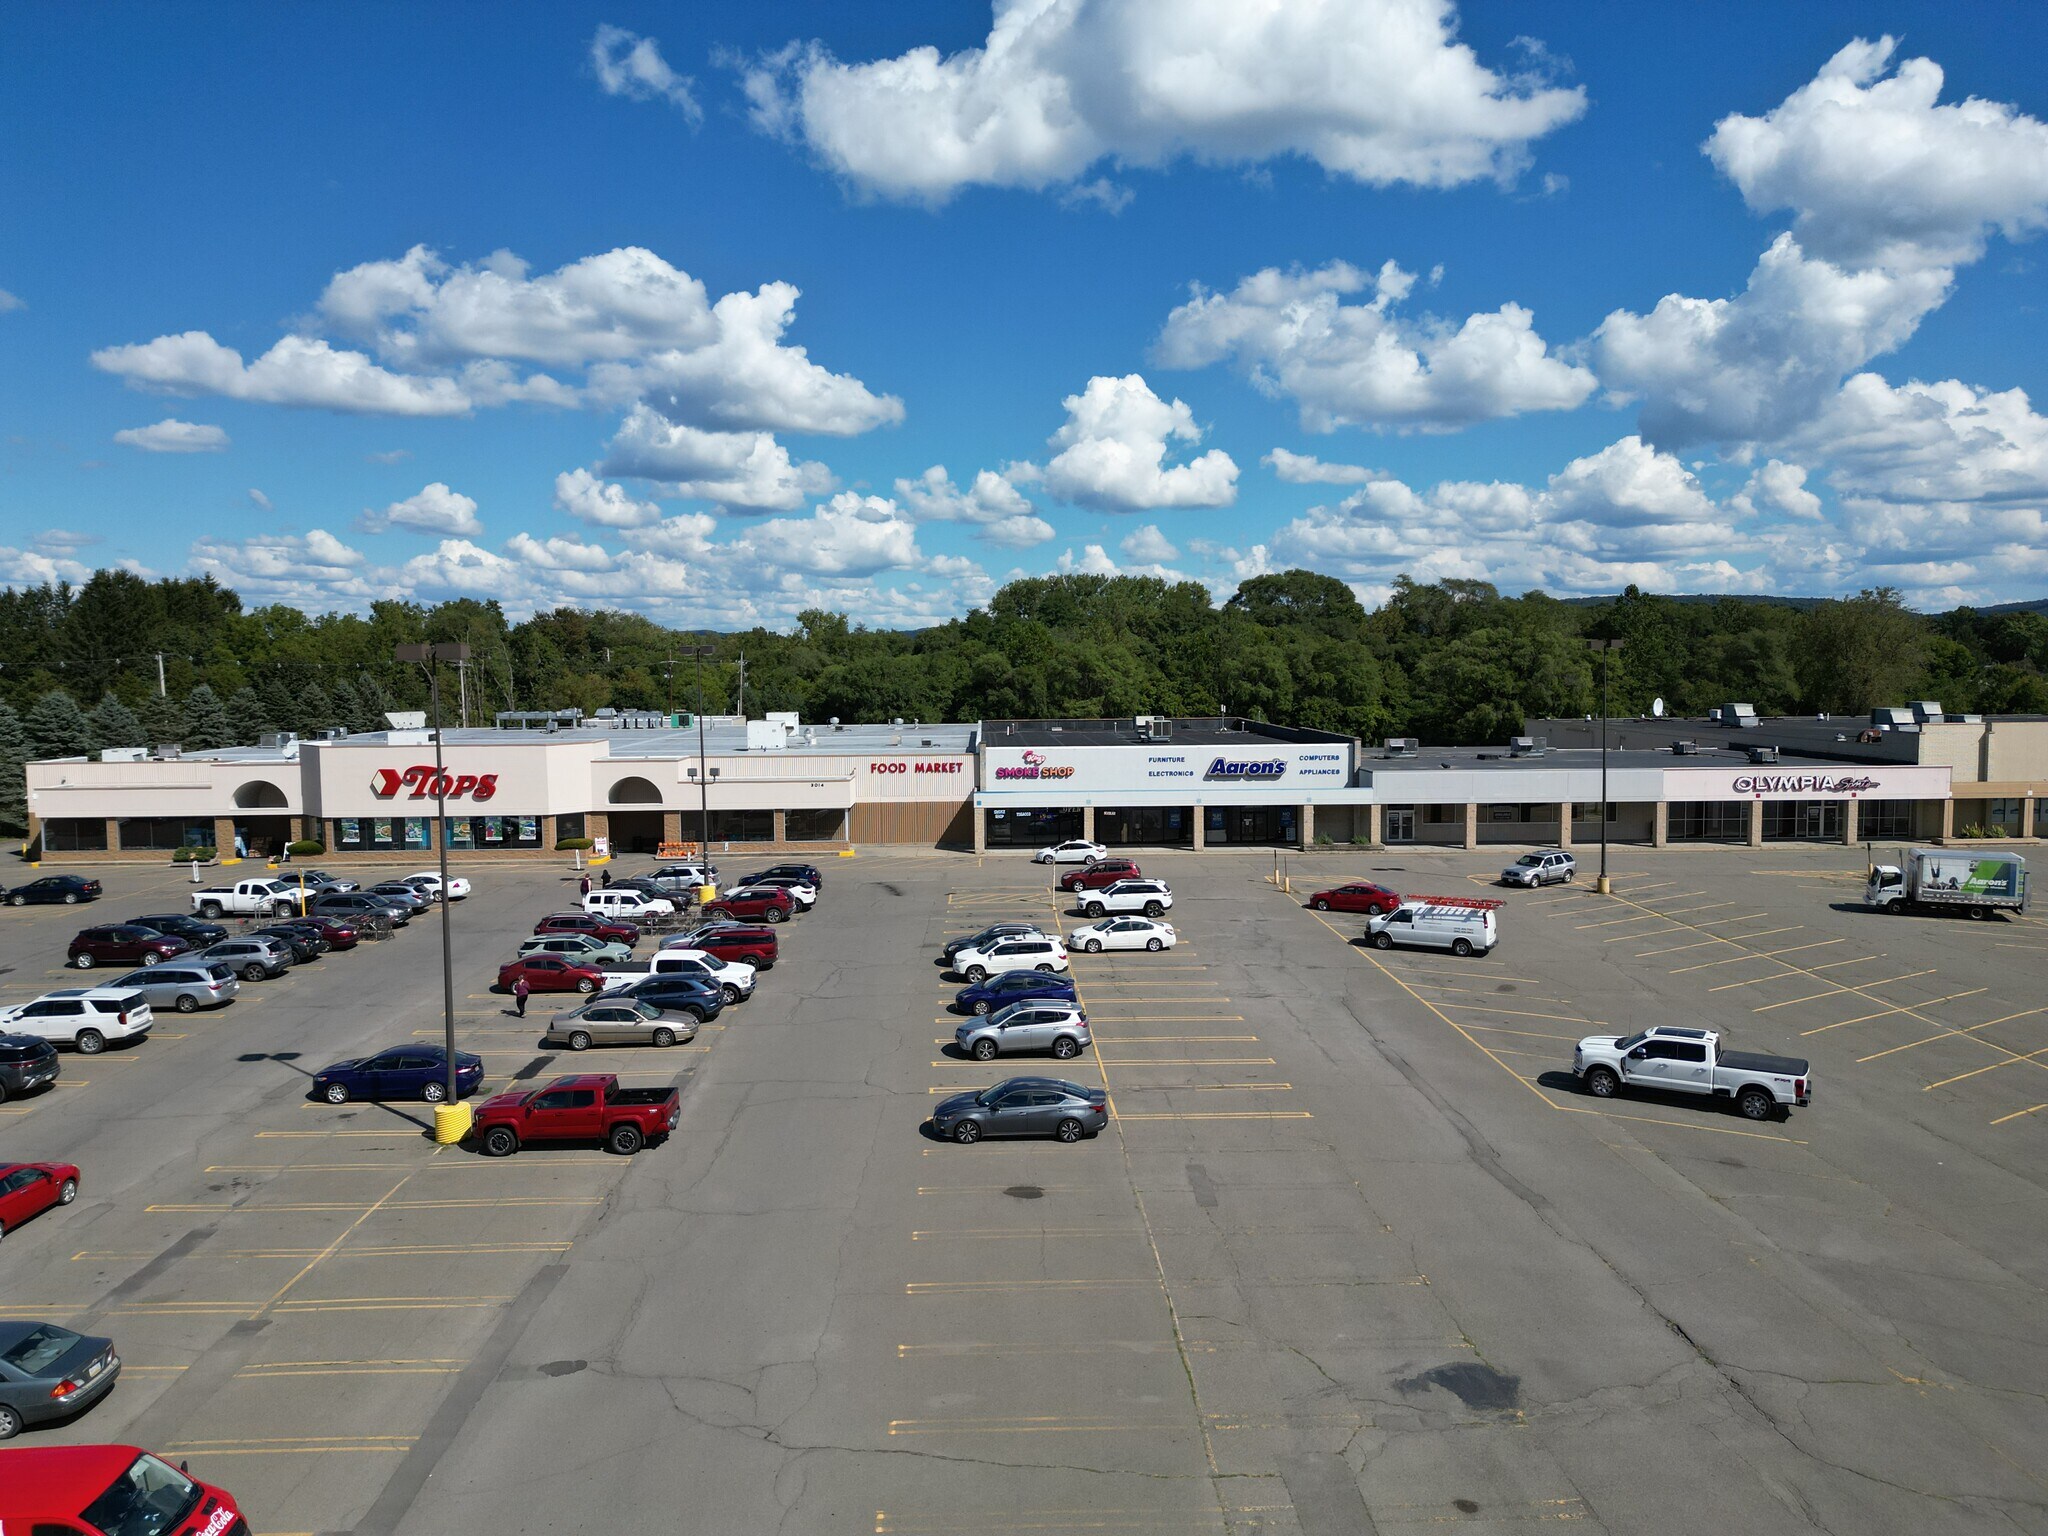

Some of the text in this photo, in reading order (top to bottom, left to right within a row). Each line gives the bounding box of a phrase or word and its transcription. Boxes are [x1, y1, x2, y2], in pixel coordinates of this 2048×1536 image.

[870, 762, 963, 774] FOOD MARKET
[996, 767, 1075, 778] SMOKE SHOP
[1207, 758, 1287, 776] Aaron's
[1736, 775, 1835, 791] OLYMPIA
[1968, 877, 2009, 886] Aaron's
